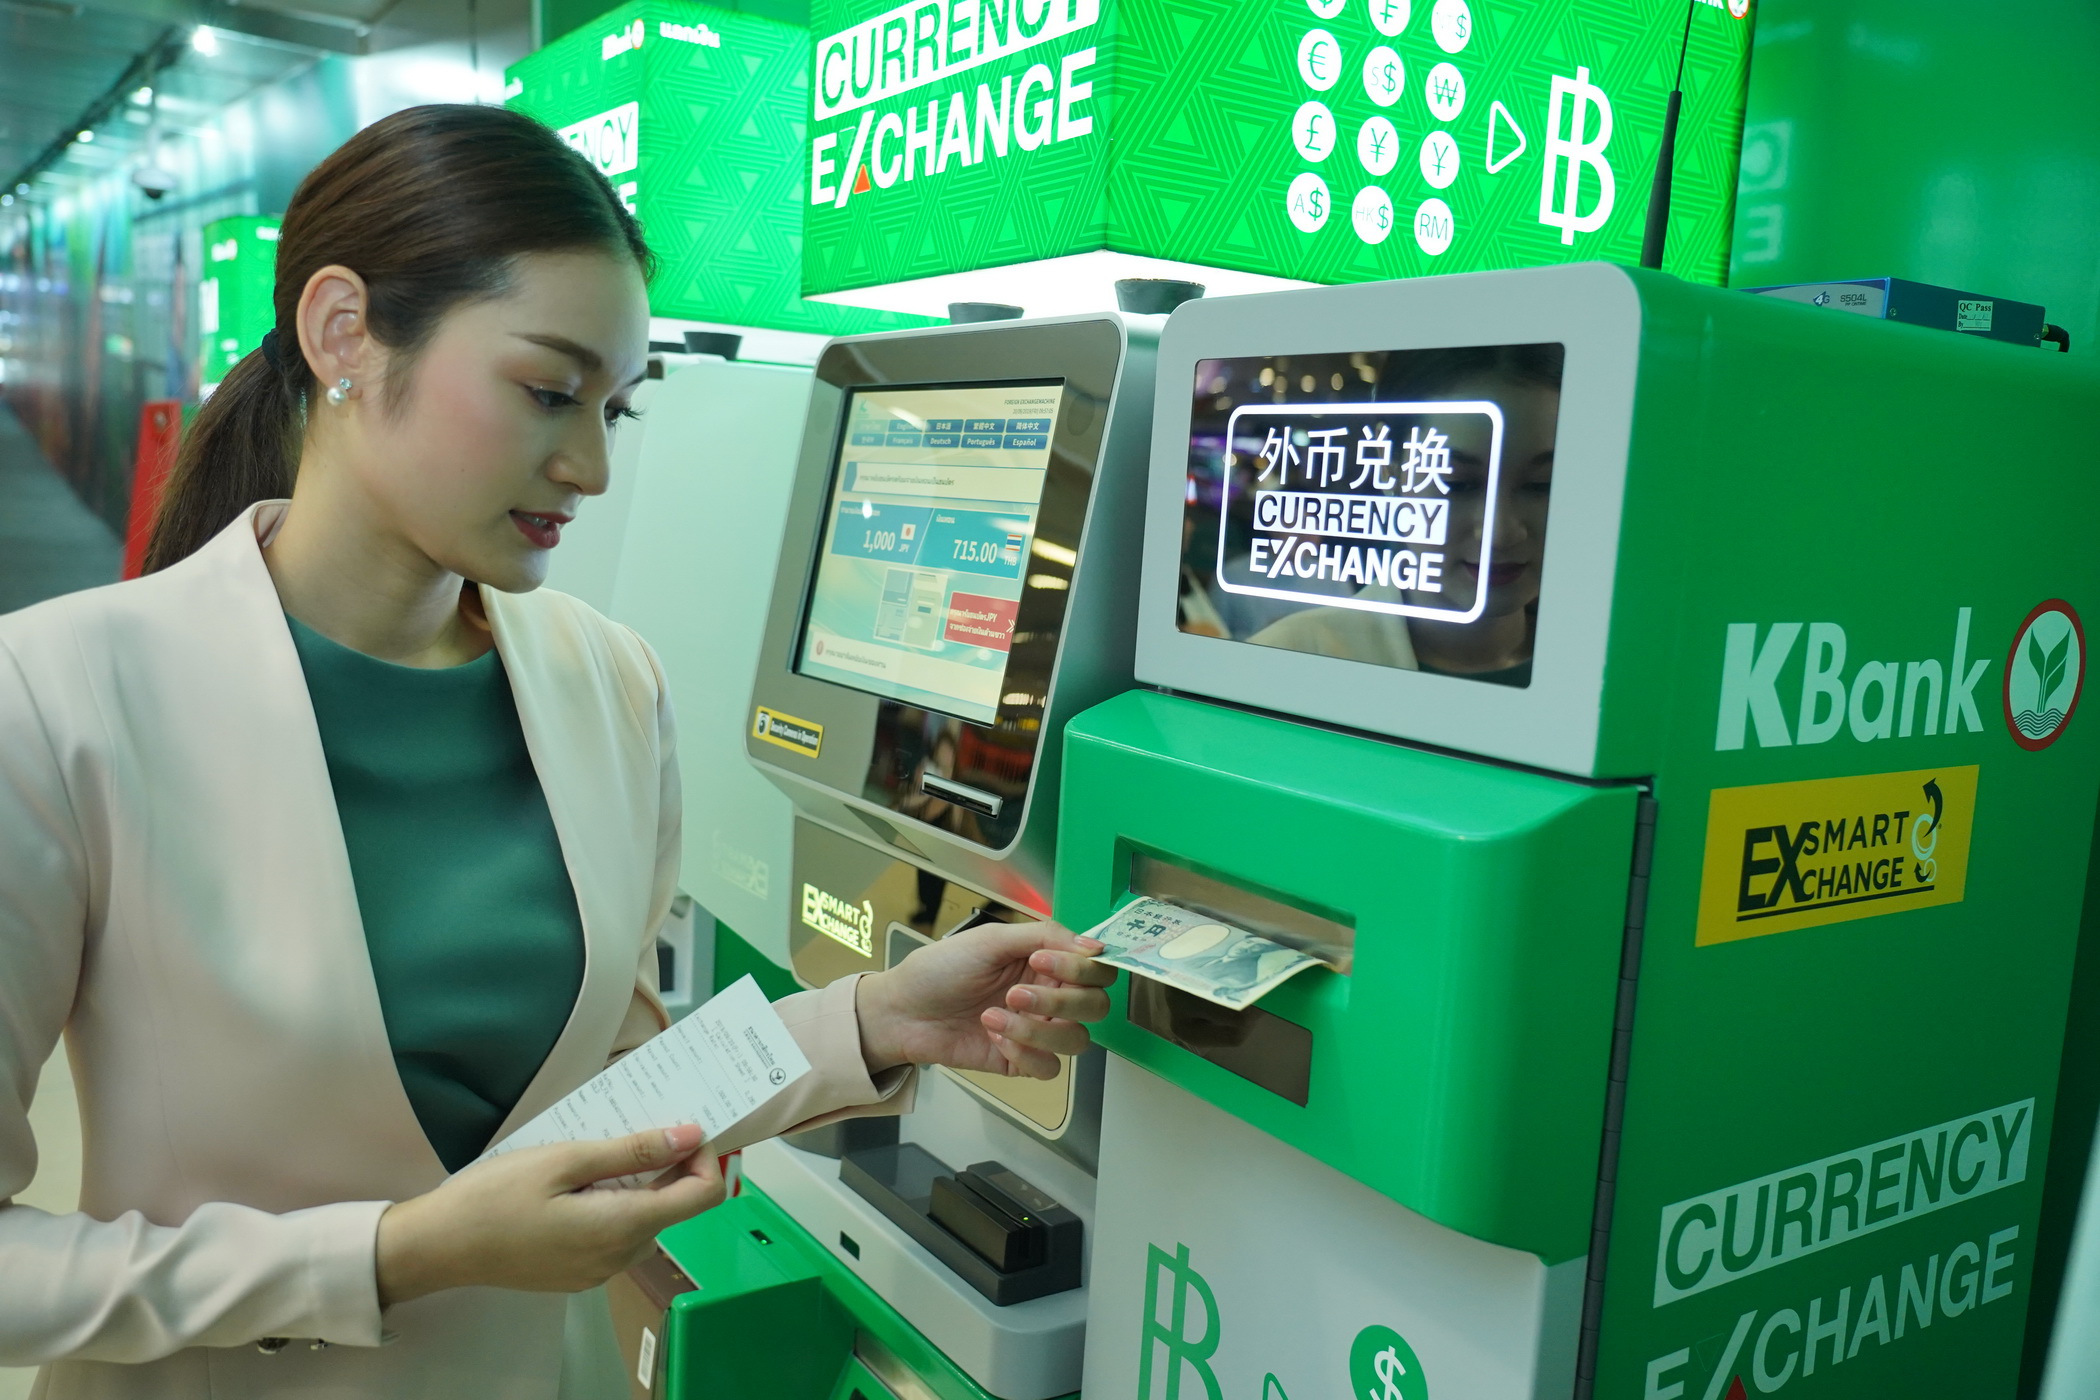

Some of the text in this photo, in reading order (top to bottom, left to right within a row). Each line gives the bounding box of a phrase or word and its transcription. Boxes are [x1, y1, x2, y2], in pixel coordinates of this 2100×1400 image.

[811, 46, 1097, 208] EXCHANGE
[1419, 213, 1448, 241] RM
[1959, 302, 1992, 312] QC Pass
[930, 437, 951, 445] Deutsch
[967, 438, 996, 446] Português
[1012, 438, 1037, 446] Español
[1258, 425, 1453, 495] 外币兑换
[1257, 494, 1443, 540] CURRENCY
[863, 529, 896, 553] 1,000
[953, 539, 1017, 566] 715.00 THB
[1250, 536, 1445, 593] EXCHANGE
[1715, 607, 1991, 751] KBank
[1802, 811, 1910, 856] SMART
[820, 891, 860, 926] SMART
[1664, 1106, 2030, 1290] CURRENCY
[1643, 1224, 2020, 1400] EXCHANGE
